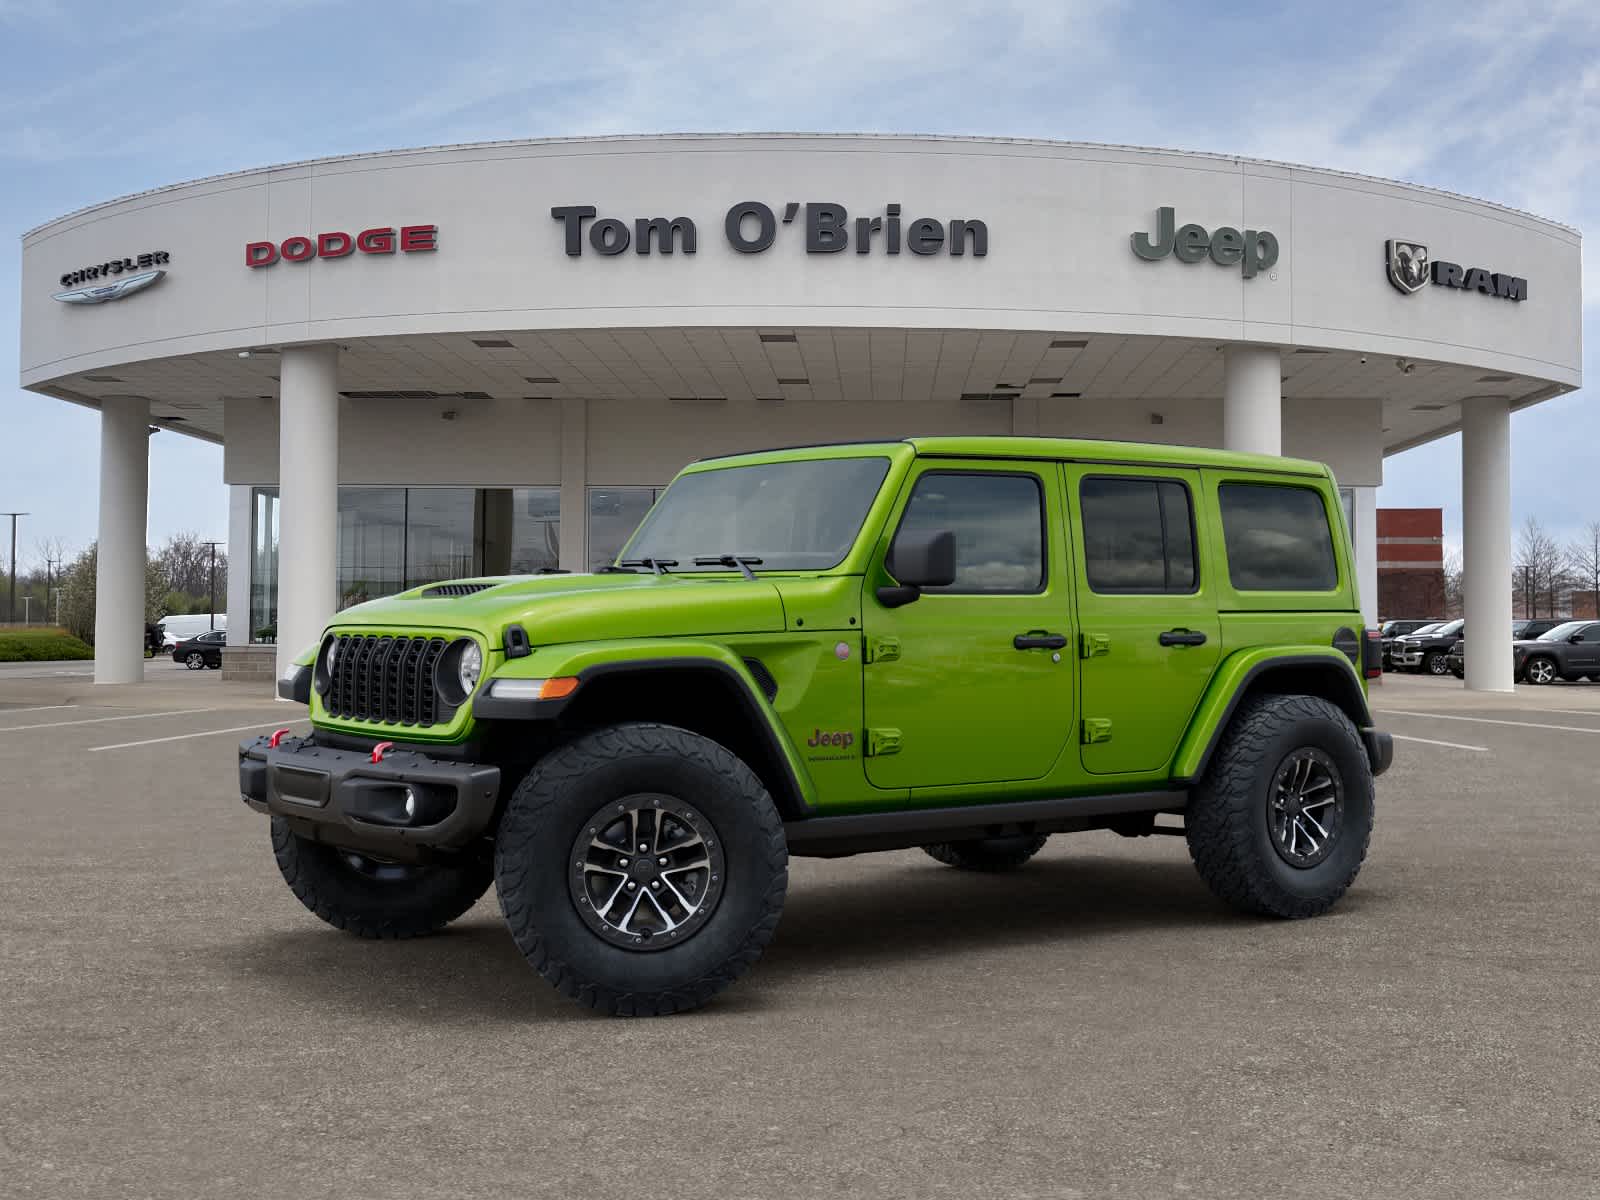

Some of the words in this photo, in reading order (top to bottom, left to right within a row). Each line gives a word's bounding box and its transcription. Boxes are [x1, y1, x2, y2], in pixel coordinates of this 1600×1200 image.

[245, 224, 438, 269] DODGE
[551, 205, 698, 256] Tom
[725, 200, 989, 256] O'Brien
[1130, 207, 1280, 279] Jeep
[60, 250, 170, 287] CHRYSLER
[1431, 260, 1528, 302] RAM
[807, 727, 855, 750] Jeep
